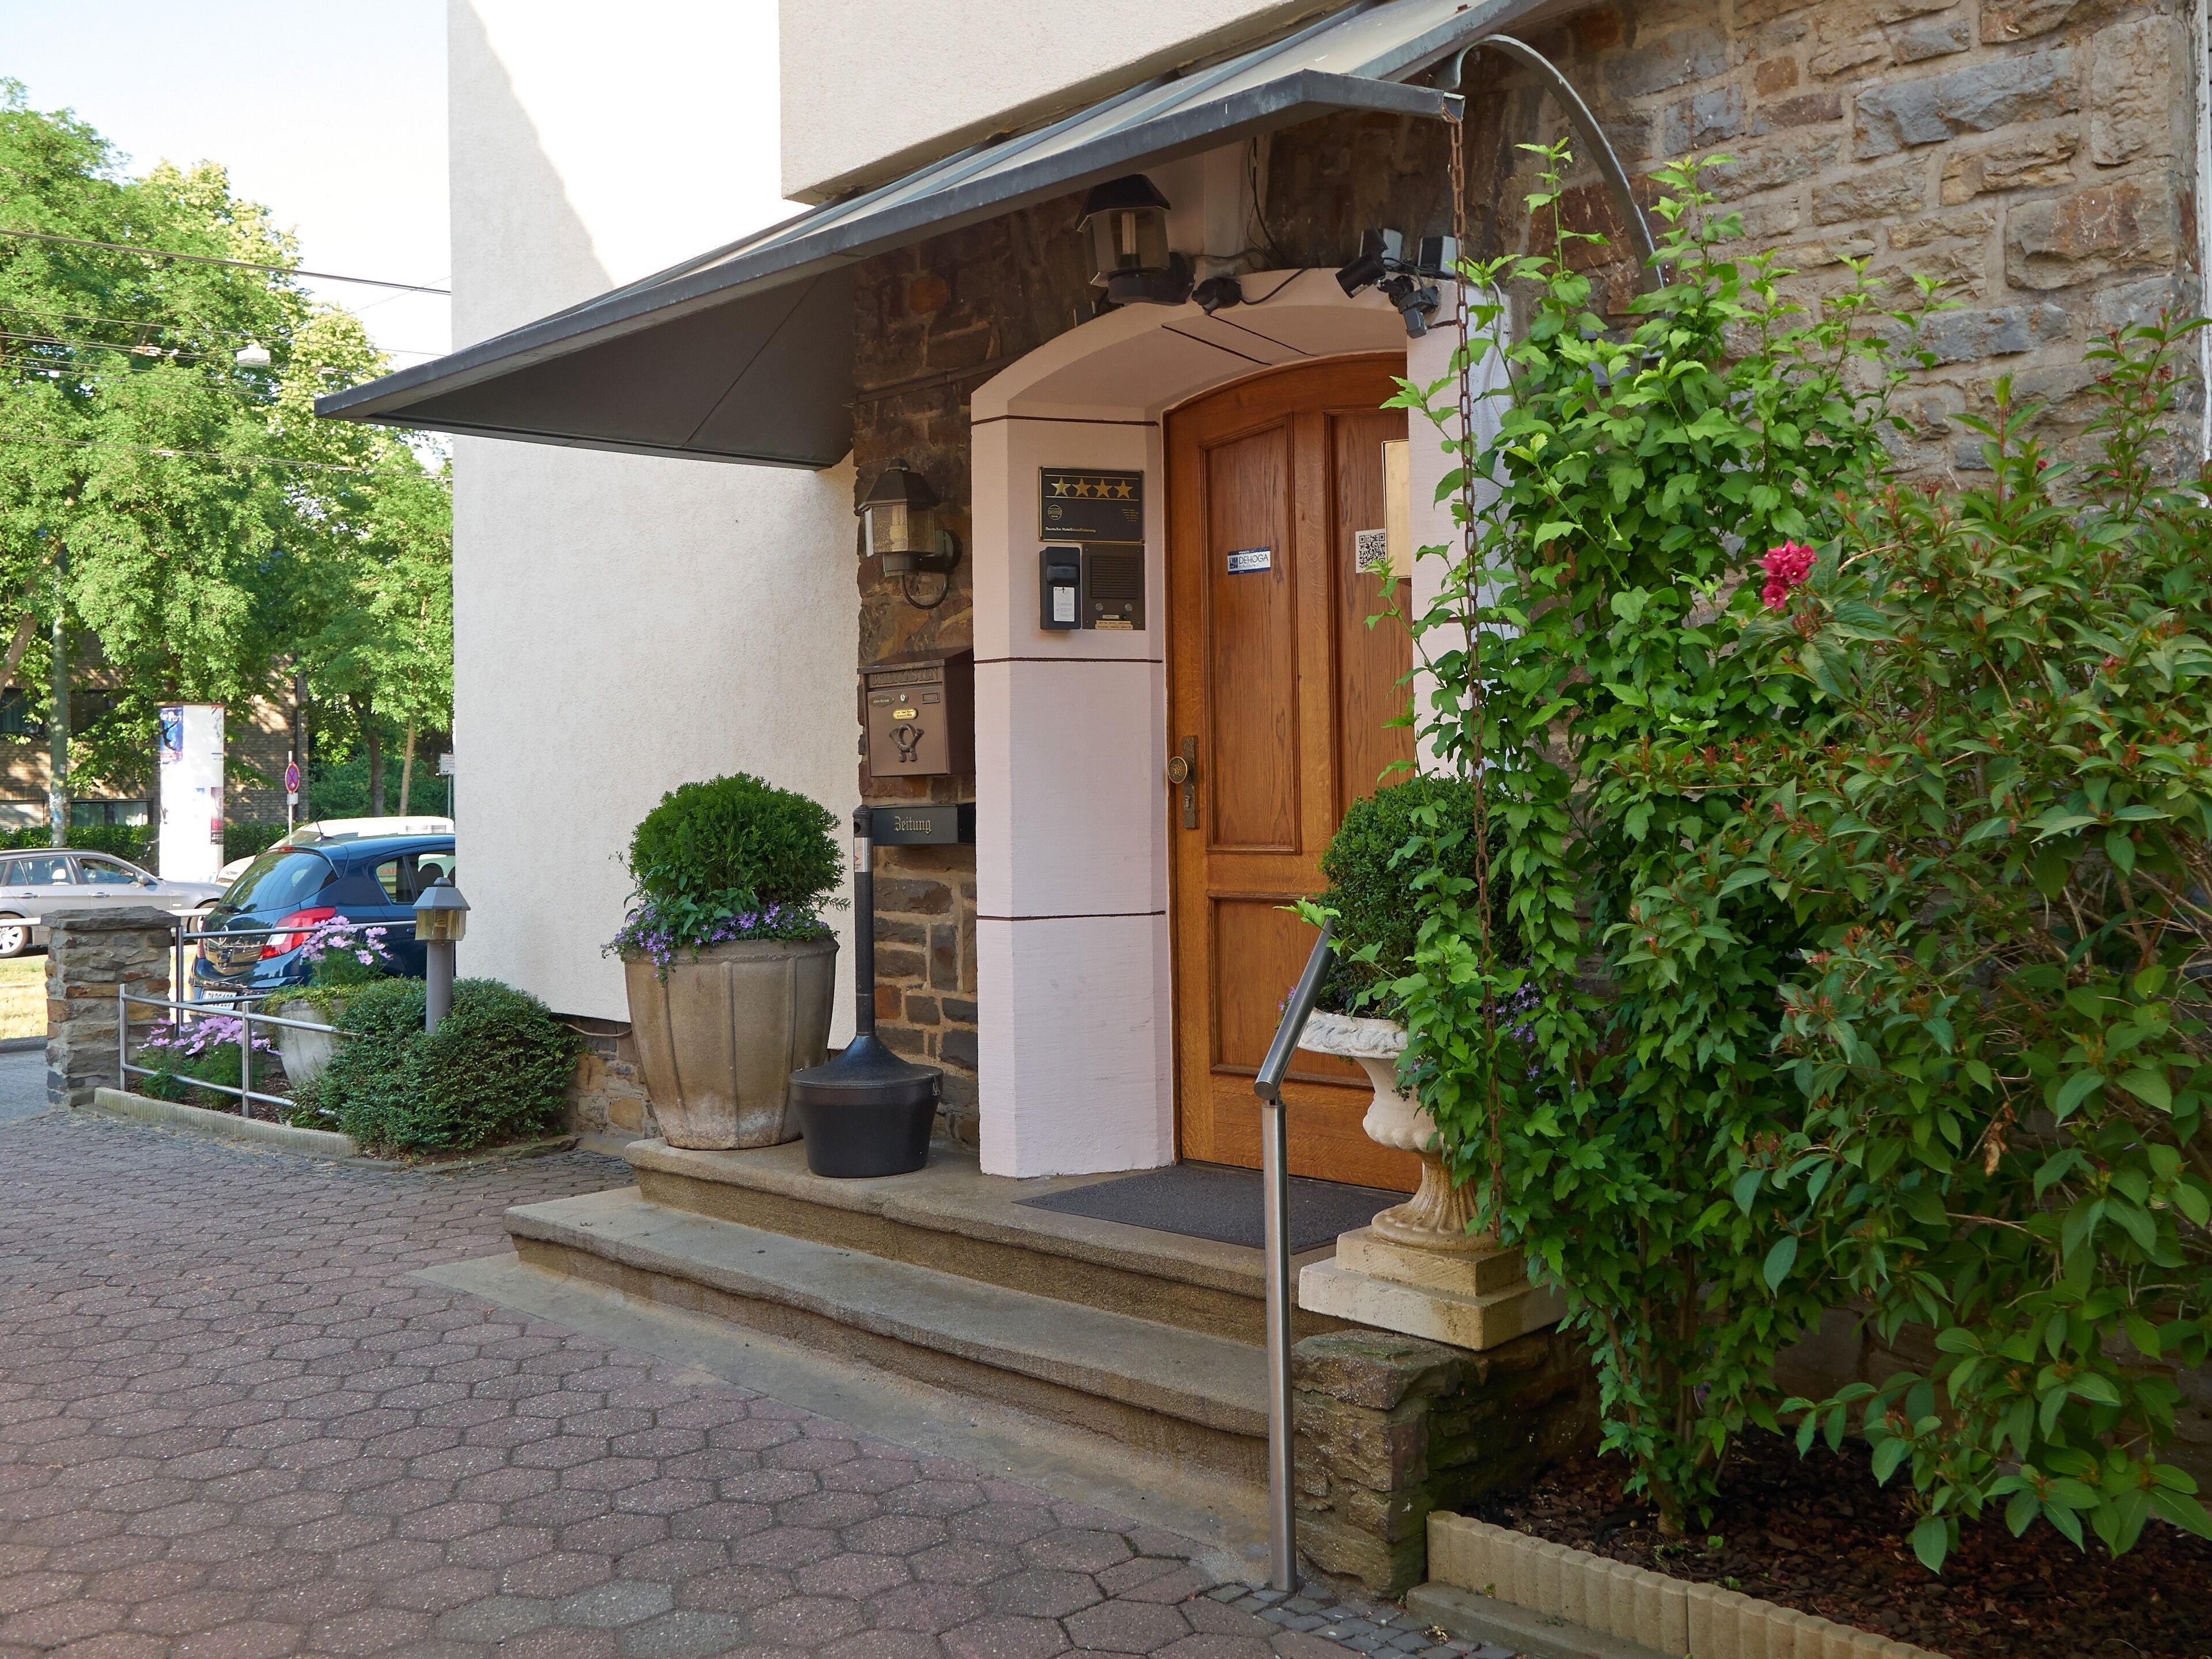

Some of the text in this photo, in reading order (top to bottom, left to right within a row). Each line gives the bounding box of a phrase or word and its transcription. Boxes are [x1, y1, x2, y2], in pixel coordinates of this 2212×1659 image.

[1238, 554, 1268, 564] DEHOGA
[871, 668, 938, 686] BRIEFKASTEN
[893, 816, 931, 834] Zeitung
